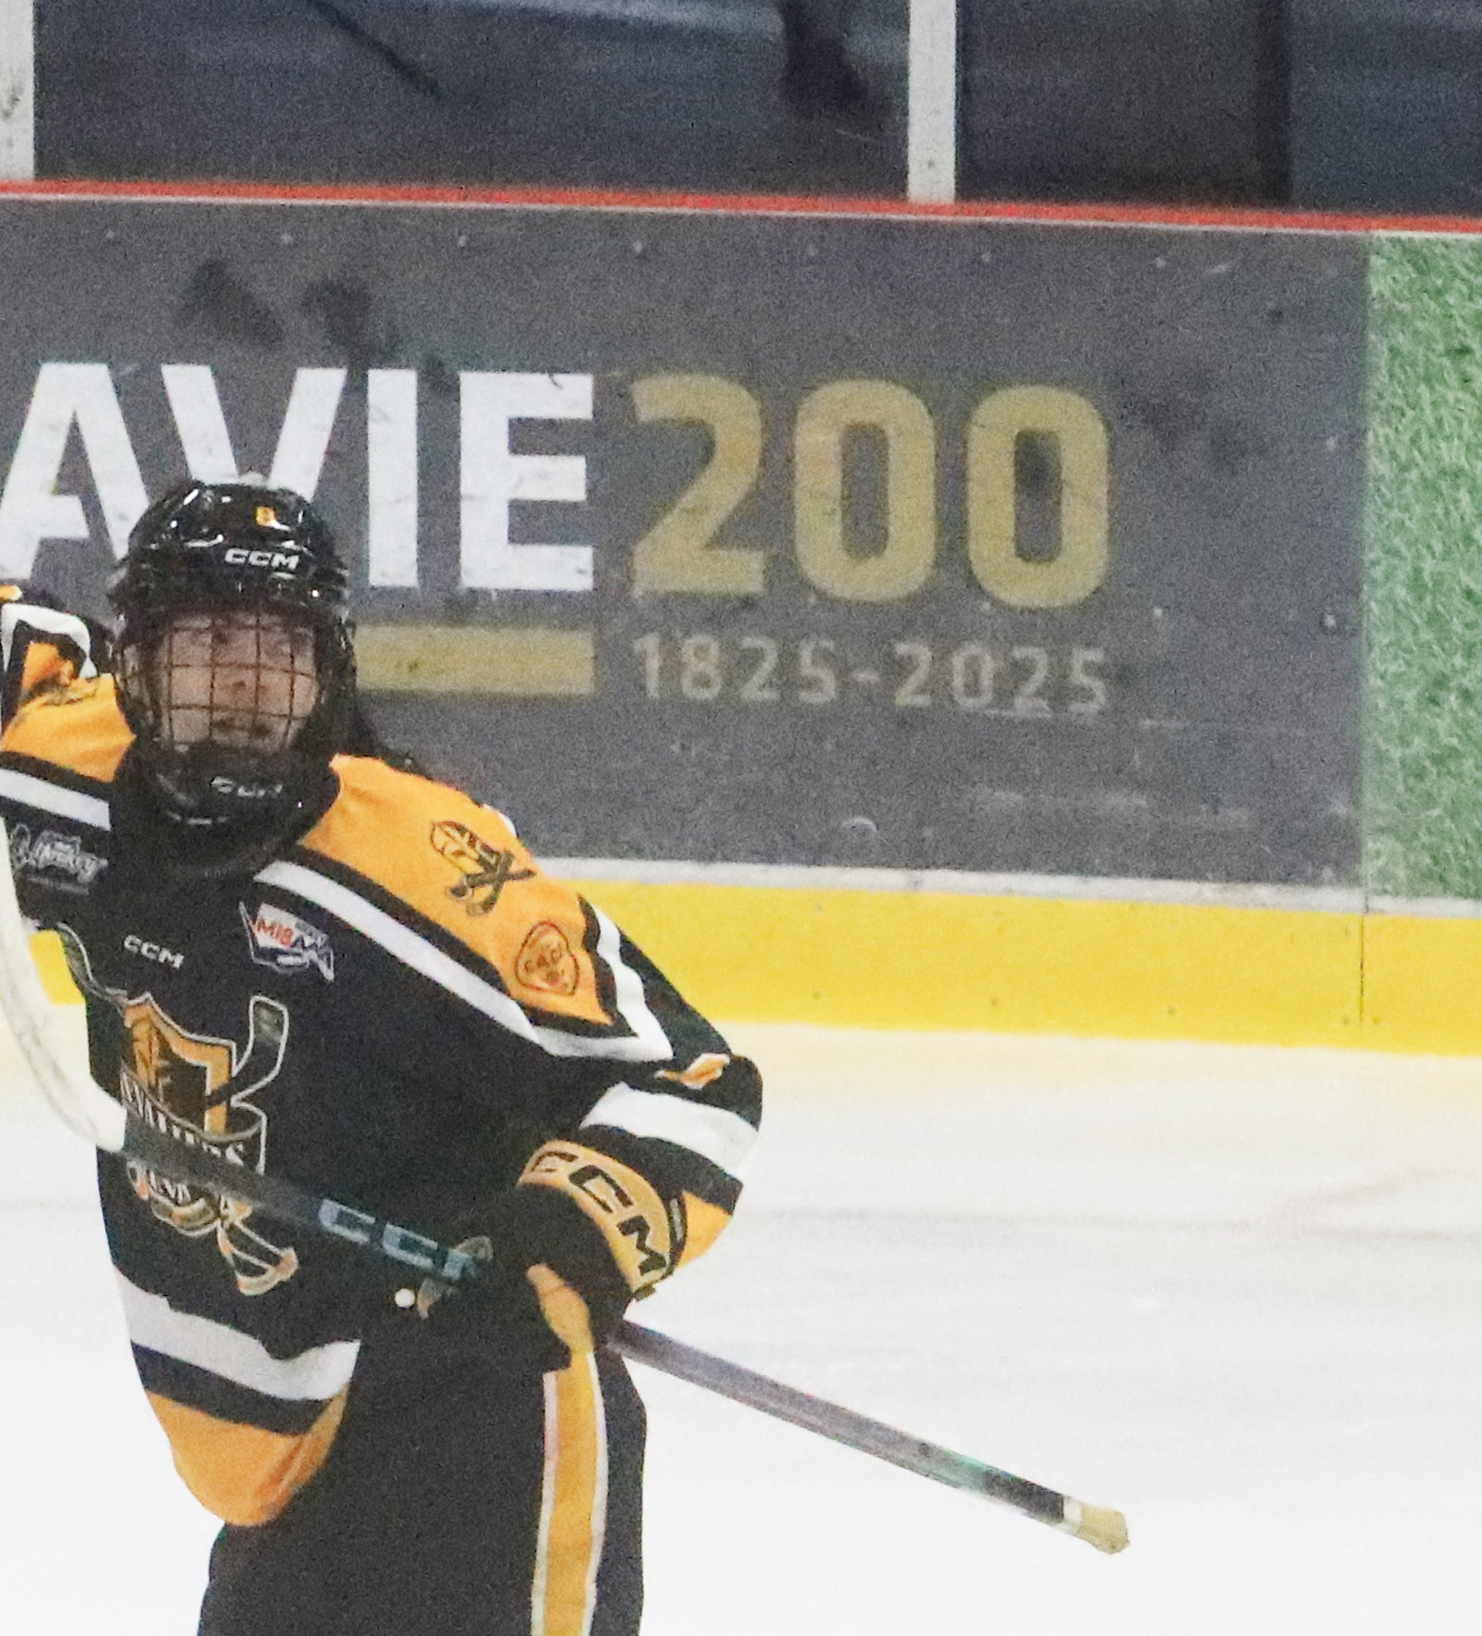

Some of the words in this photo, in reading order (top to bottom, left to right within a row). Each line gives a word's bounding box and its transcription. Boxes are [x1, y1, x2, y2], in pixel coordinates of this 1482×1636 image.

[628, 372, 1110, 607] 200
[224, 549, 300, 569] CCM
[635, 634, 1108, 716] 1825-2025
[122, 933, 184, 969] CCM
